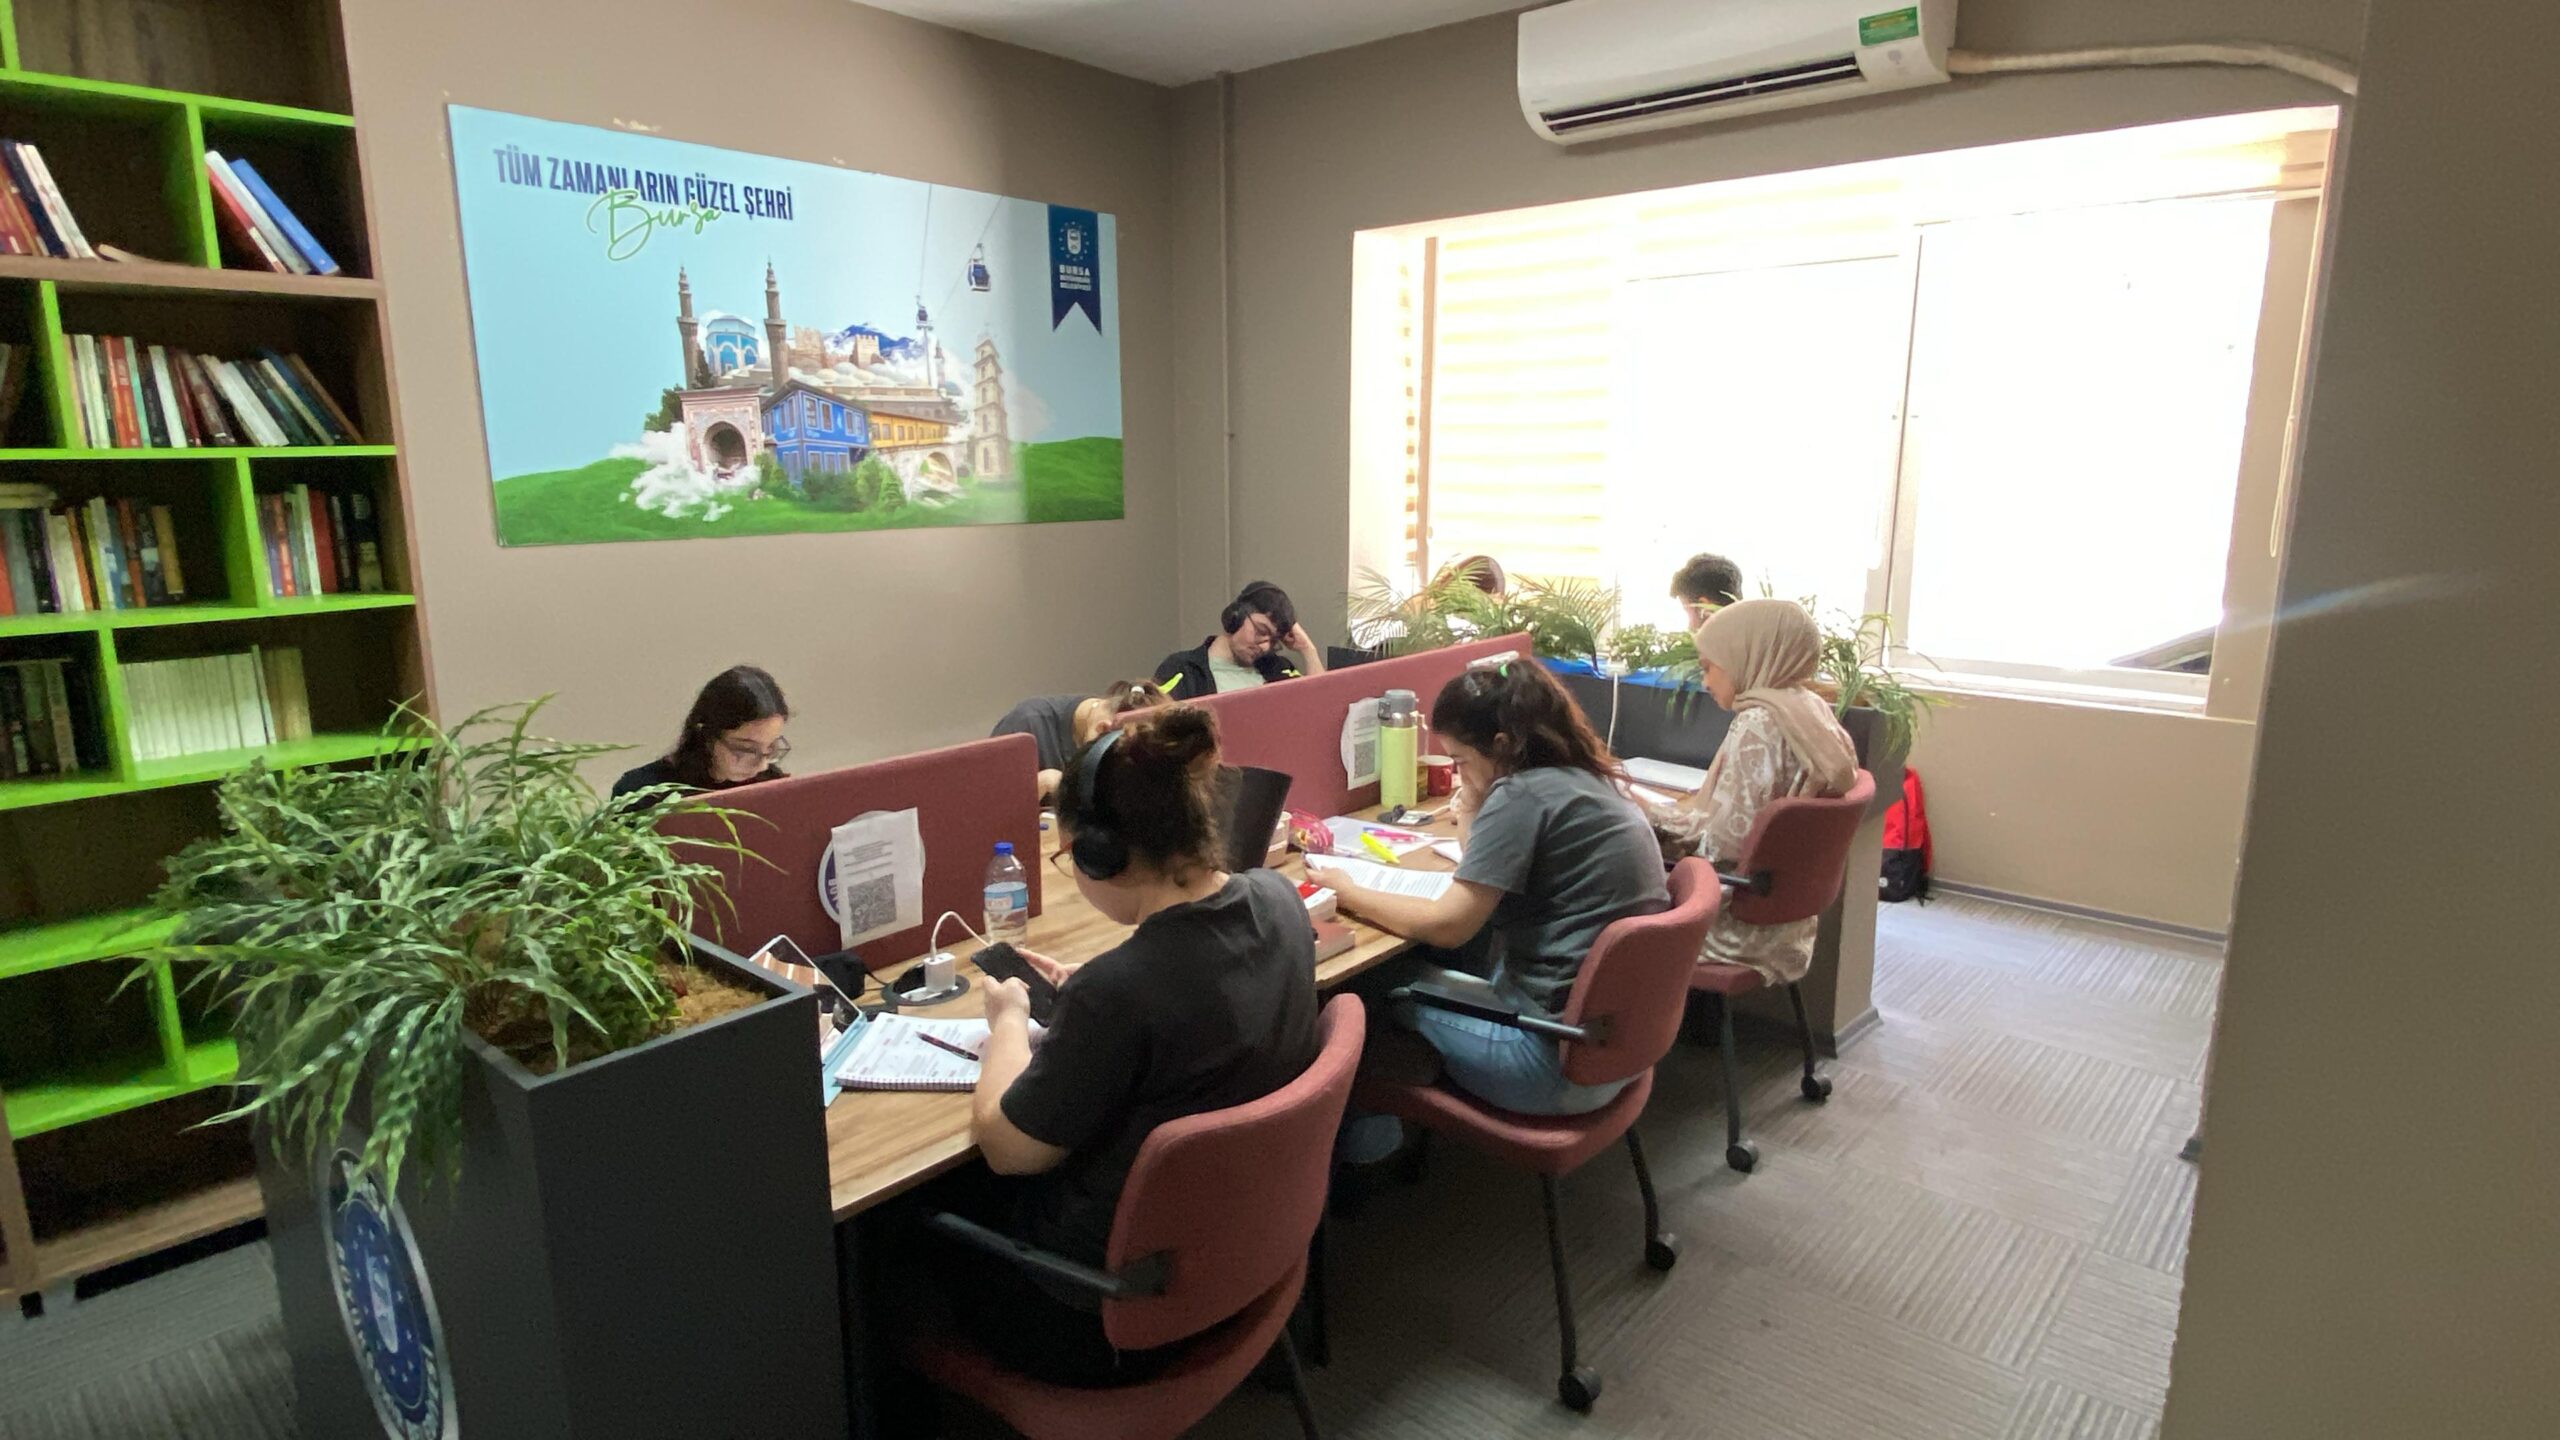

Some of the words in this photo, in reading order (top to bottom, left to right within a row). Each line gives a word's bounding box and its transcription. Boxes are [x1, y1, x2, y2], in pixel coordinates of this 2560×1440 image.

[493, 144, 543, 188] TÜM
[683, 172, 741, 214] GÜZEL
[744, 185, 794, 221] ŞEHRİ
[586, 188, 722, 261] Bursa
